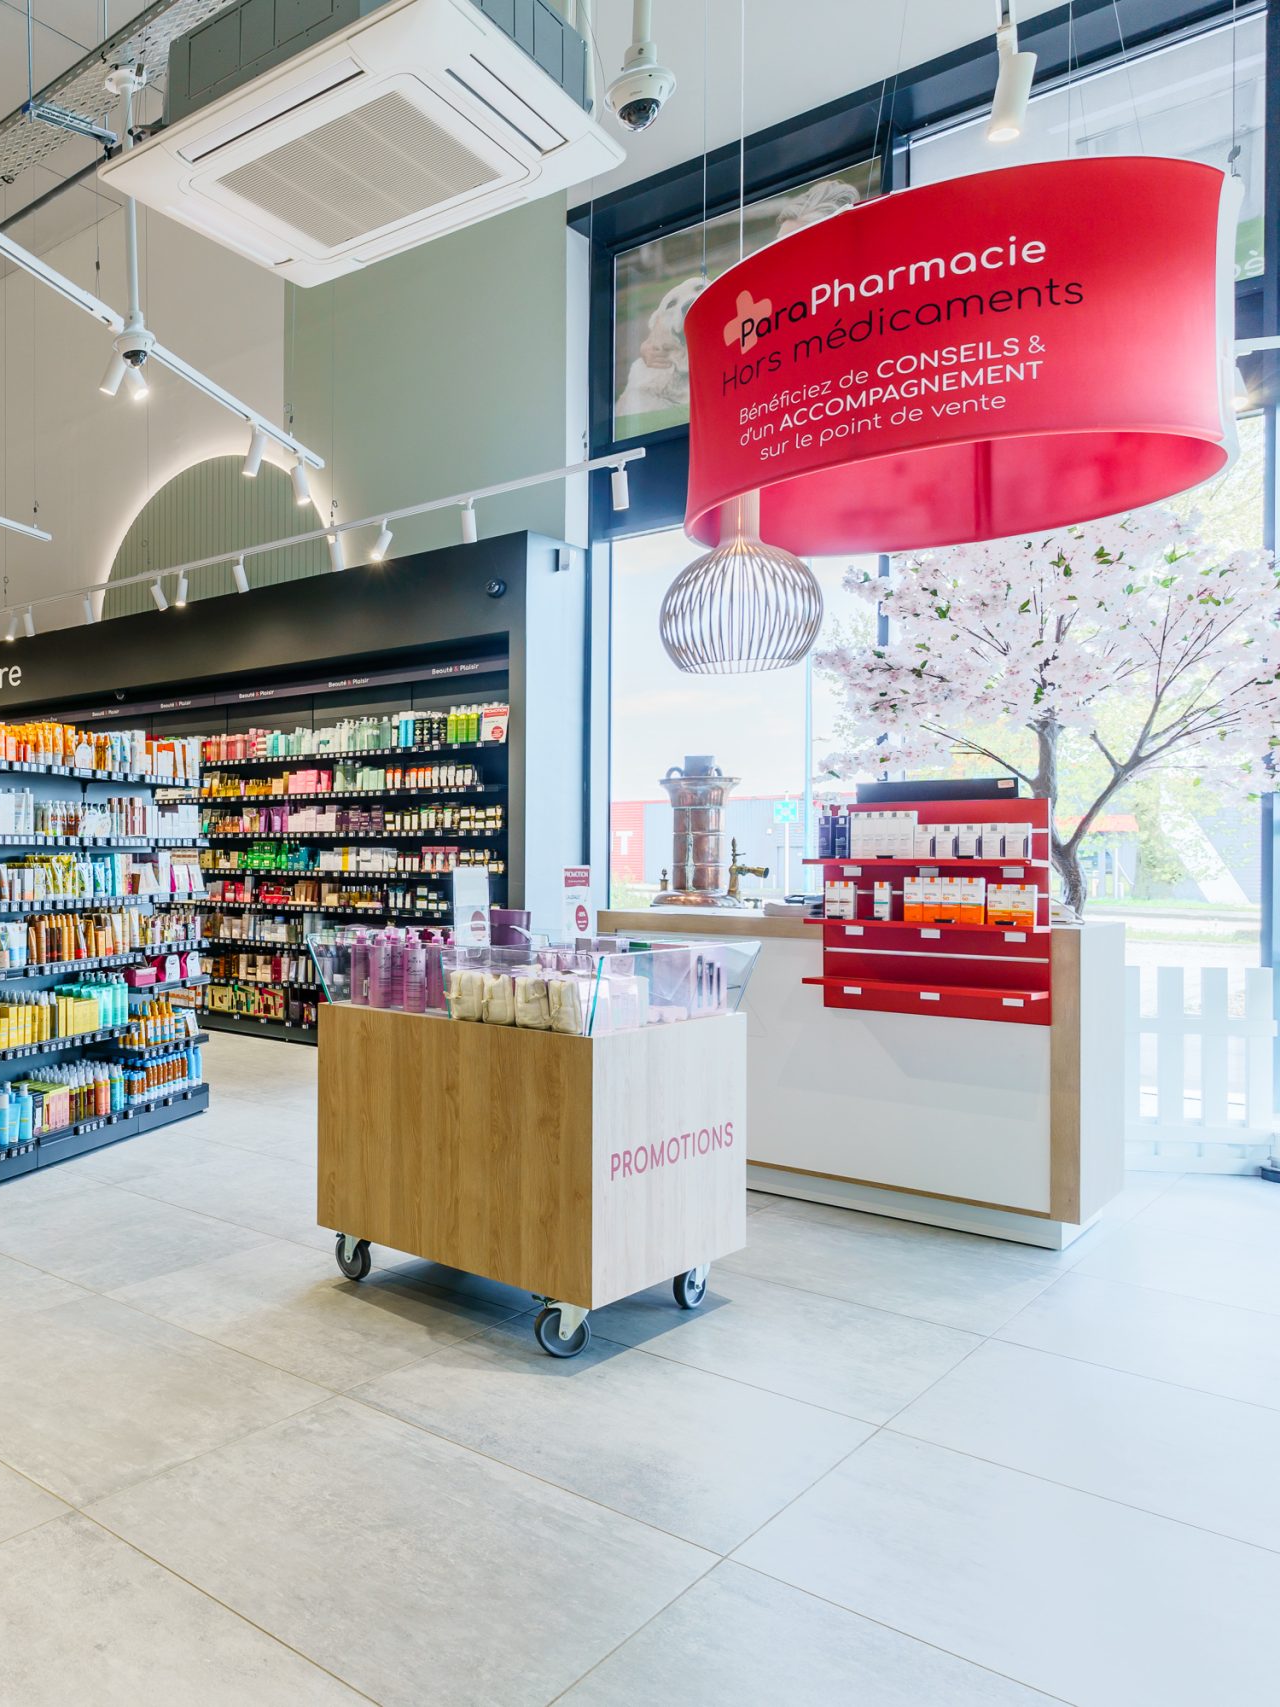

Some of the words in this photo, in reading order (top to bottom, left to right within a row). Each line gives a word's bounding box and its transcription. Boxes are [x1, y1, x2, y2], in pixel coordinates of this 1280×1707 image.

[740, 236, 1046, 347] ParaPharmacie
[722, 347, 782, 396] Hors
[794, 278, 1084, 363] médicaments
[739, 379, 831, 425] Bénéficiez
[839, 367, 869, 387] de
[876, 337, 1019, 379] CONSEILS
[1028, 335, 1046, 353] &
[739, 421, 775, 446] d'un
[779, 360, 1043, 430] ACCOMPAGNEMENT
[760, 440, 789, 461] sur
[794, 431, 813, 449] le
[820, 411, 883, 446] point
[890, 406, 923, 428] de
[932, 393, 1006, 418] vente
[610, 1122, 734, 1181] PROMOTIONS
